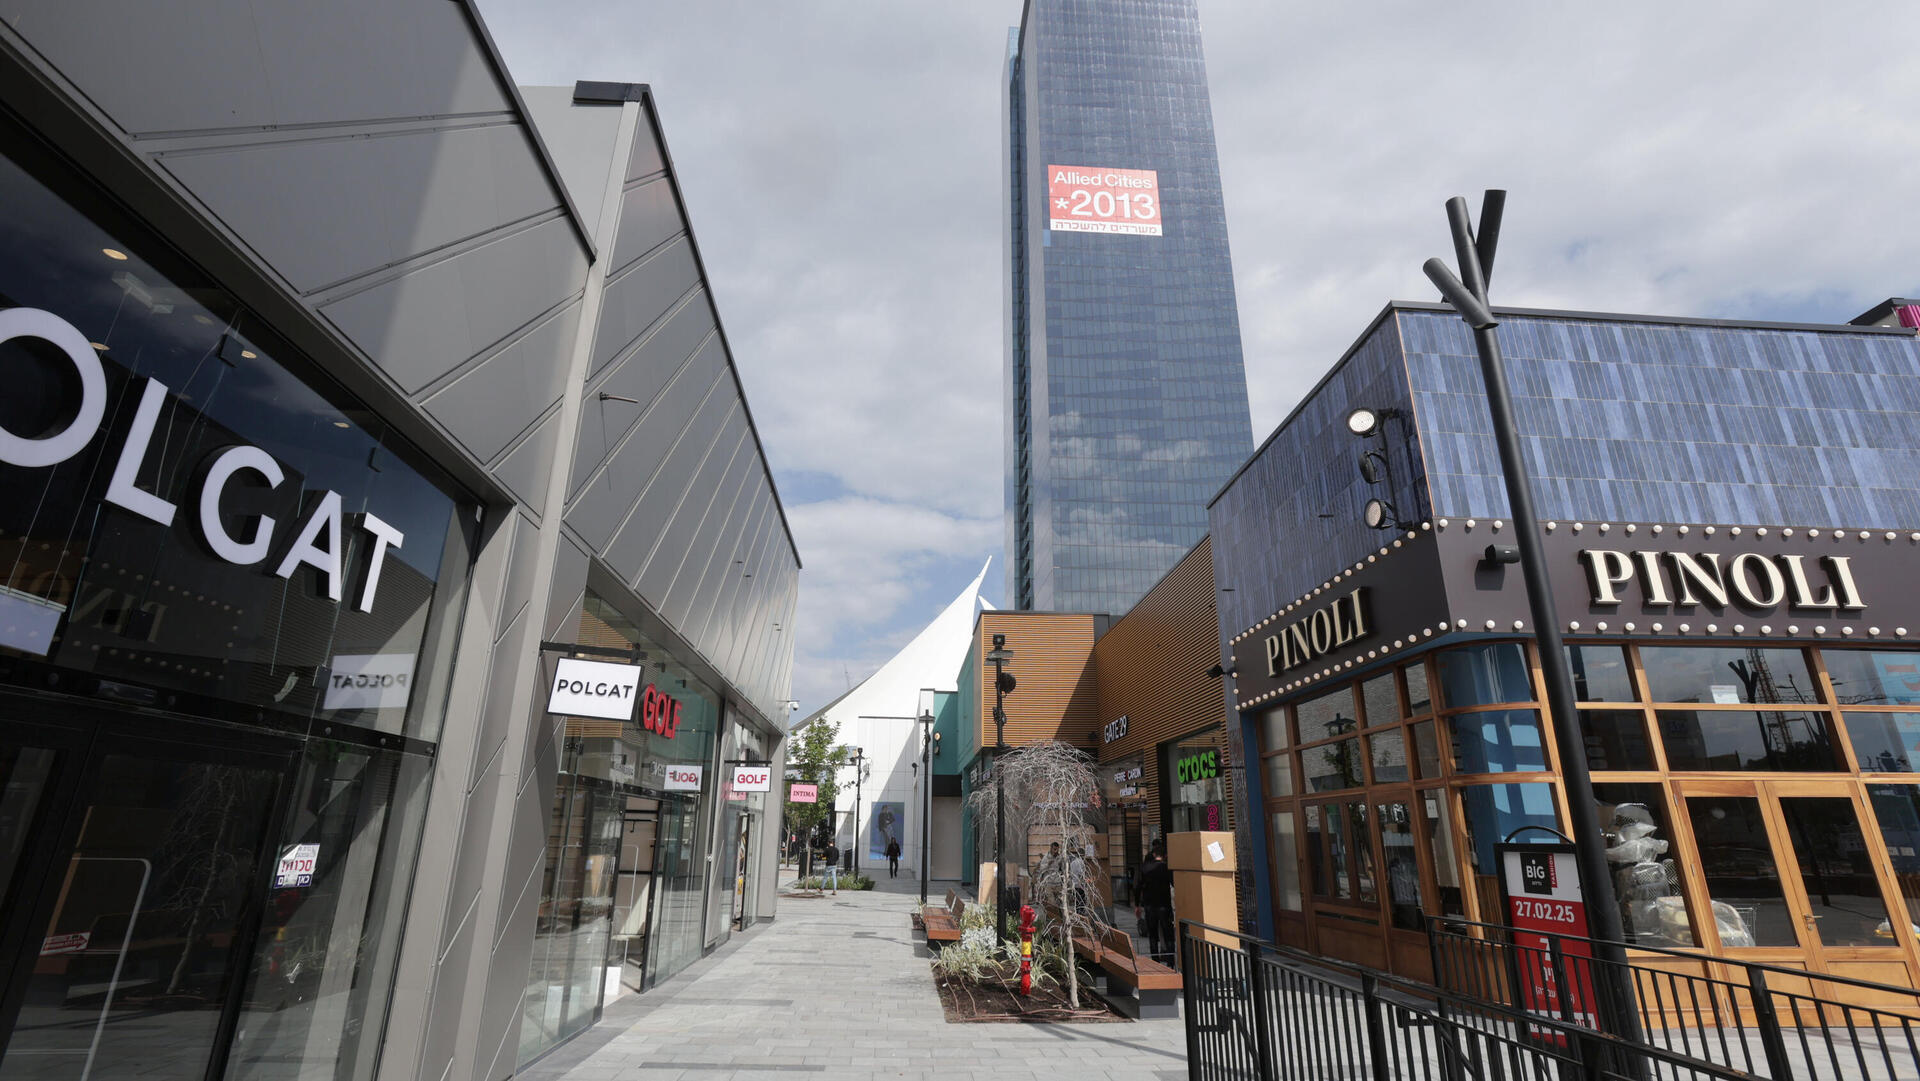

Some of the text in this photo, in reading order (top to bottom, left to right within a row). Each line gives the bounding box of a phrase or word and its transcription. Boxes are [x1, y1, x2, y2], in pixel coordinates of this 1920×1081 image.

[1054, 171, 1153, 188] Allied Cities
[1055, 220, 1157, 234] משרדים להשכרה
[1583, 548, 1868, 610] PINOLI
[1265, 586, 1369, 677] PINOLI
[557, 678, 633, 699] POLGAT
[642, 682, 683, 740] GOLF
[1104, 715, 1128, 743] GATE 29
[1177, 750, 1217, 783] crocs
[737, 773, 767, 785] GOLF
[793, 790, 815, 798] INTIMA
[1515, 900, 1575, 923] 27.02.25
